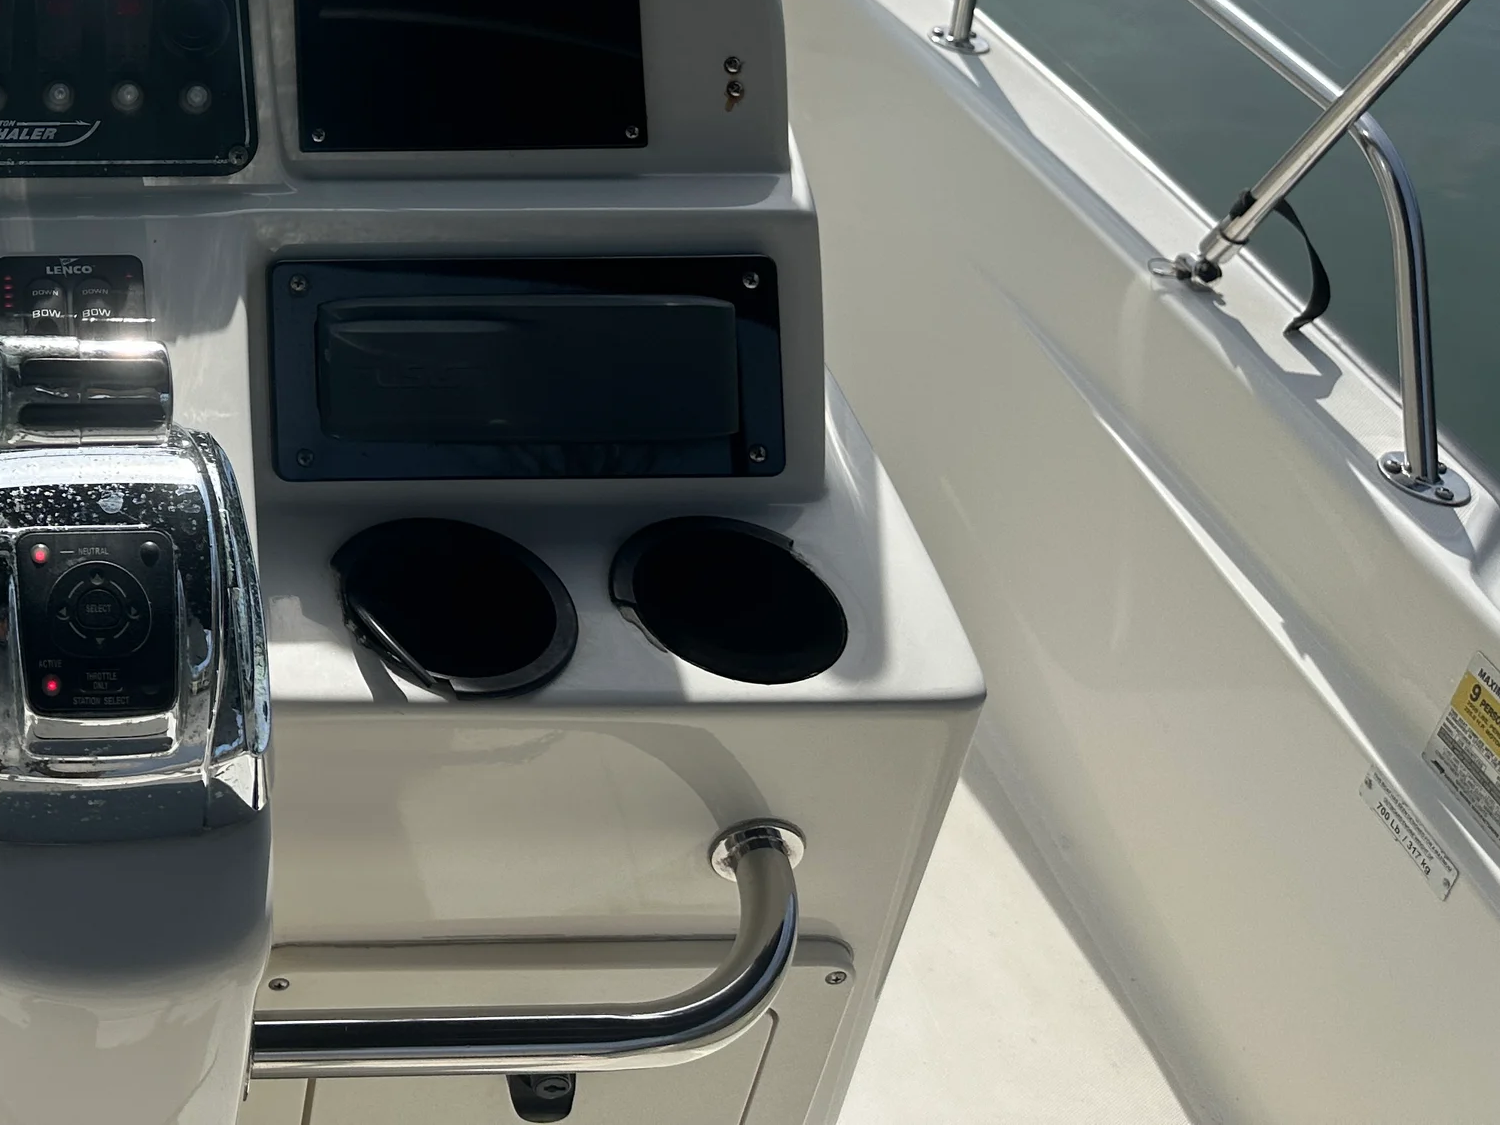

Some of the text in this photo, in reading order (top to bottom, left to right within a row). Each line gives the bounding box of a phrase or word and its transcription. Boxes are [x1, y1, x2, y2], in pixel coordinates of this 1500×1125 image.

[46, 265, 93, 275] LENCO
[32, 307, 112, 319] BOW BOW
[78, 547, 109, 555] NEUTRAL
[85, 603, 112, 613] SELECT
[39, 659, 62, 668] ACTIVE
[86, 672, 117, 681] THROTTLE
[93, 681, 108, 690] ONLY
[1470, 683, 1482, 703] 9
[73, 696, 130, 705] STATION SELECT
[1376, 802, 1389, 820] 700
[1406, 841, 1422, 859] 317
